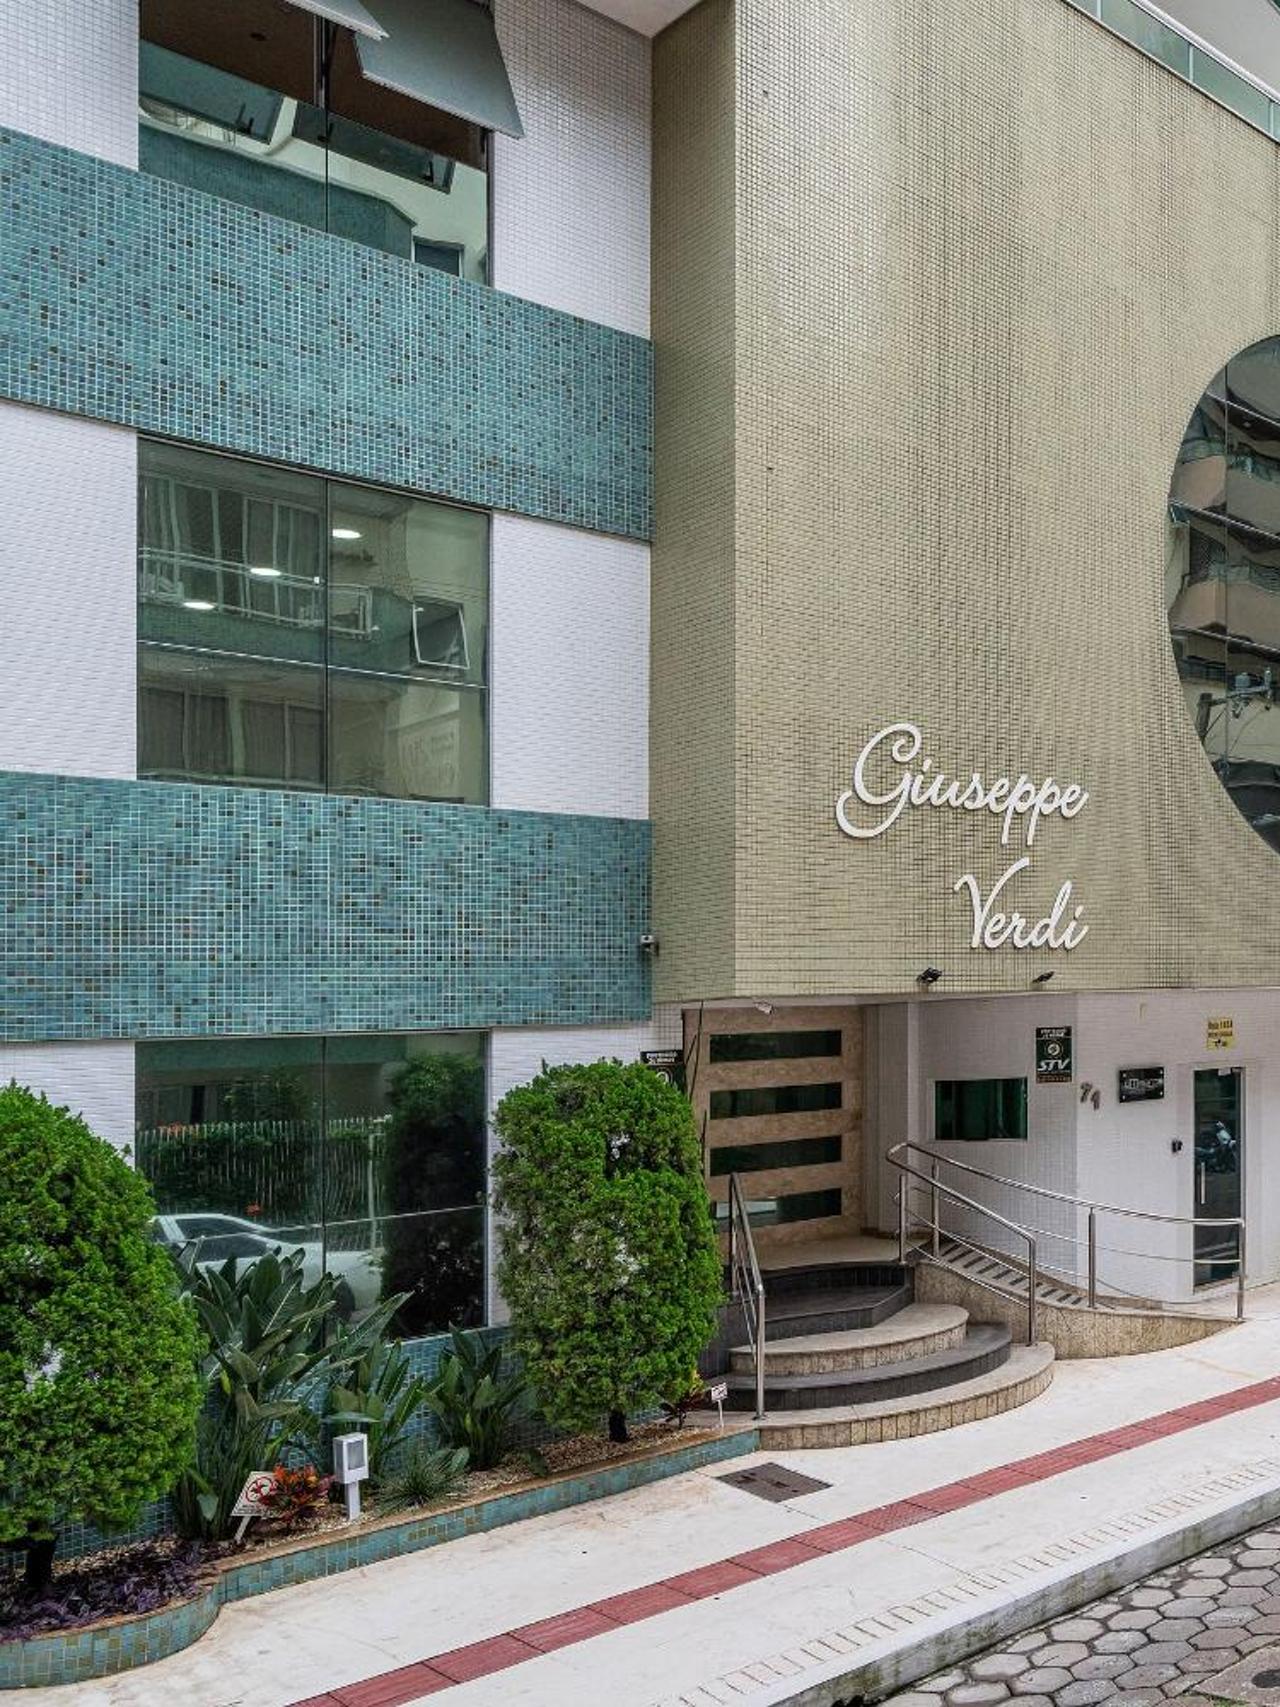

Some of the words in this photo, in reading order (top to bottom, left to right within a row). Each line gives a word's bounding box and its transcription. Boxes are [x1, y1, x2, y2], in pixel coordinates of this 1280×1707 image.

[835, 722, 1090, 846] Giuseppe
[953, 856, 1090, 951] Verdi
[1037, 1057, 1071, 1072] STV
